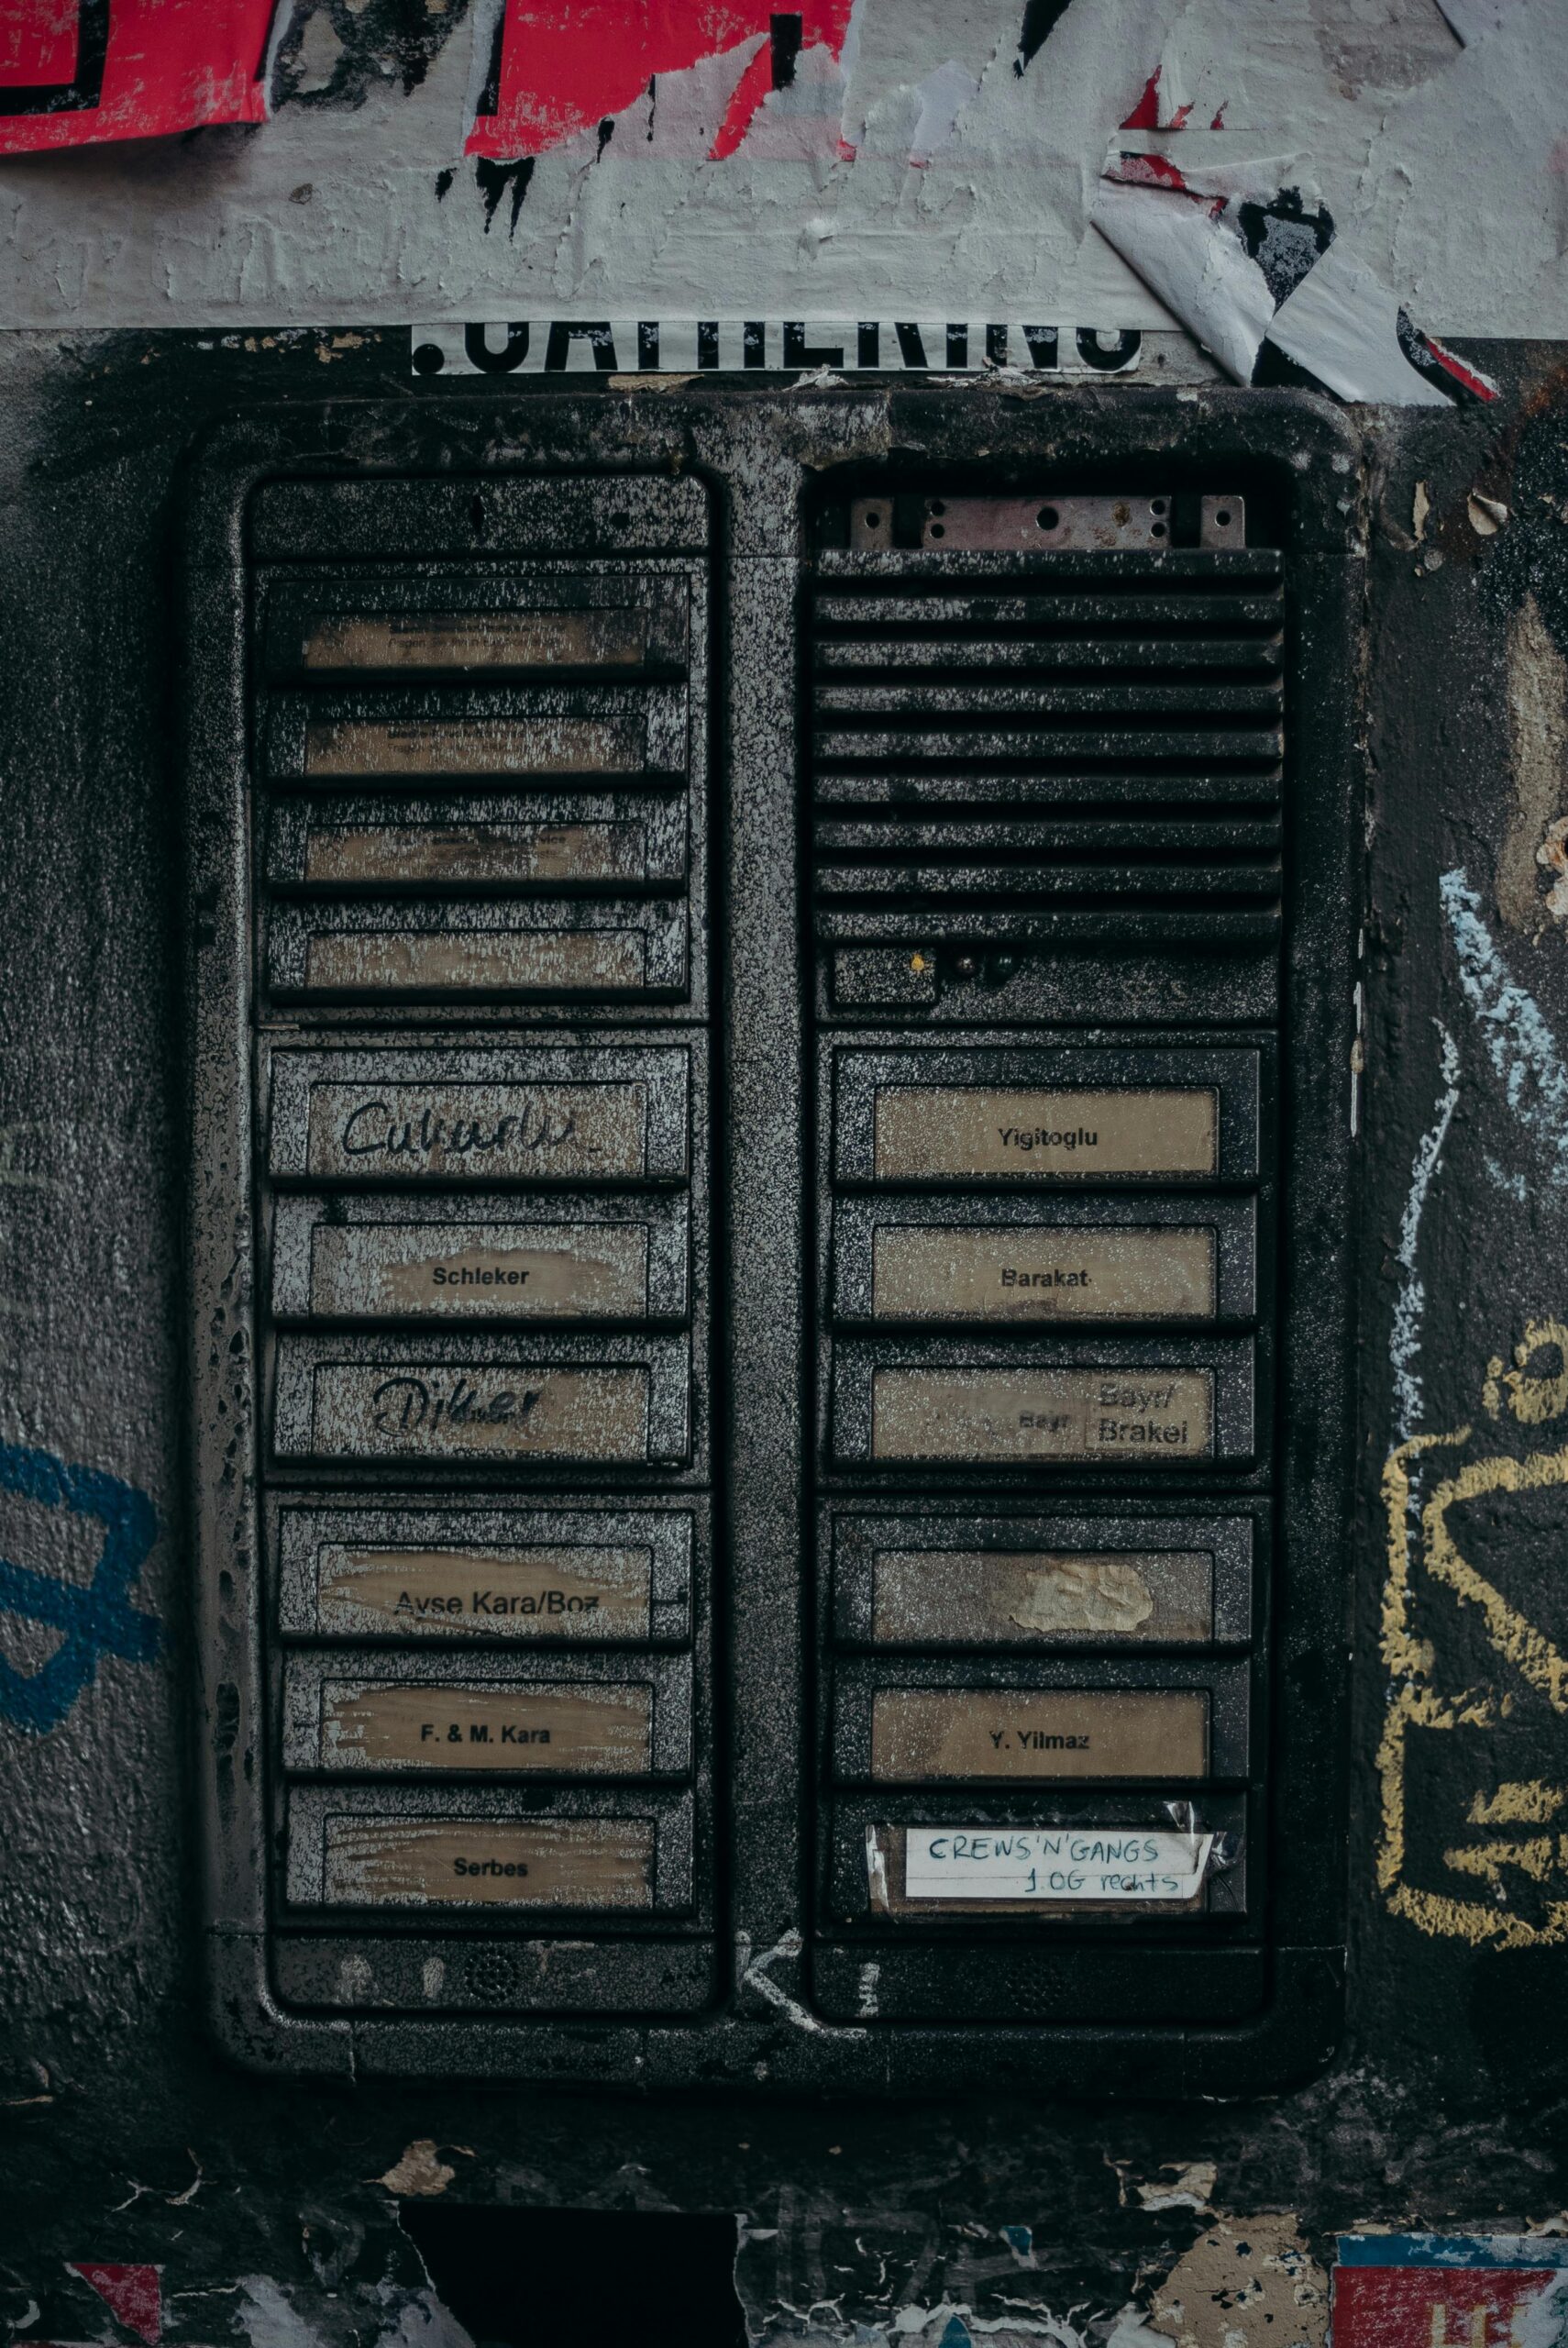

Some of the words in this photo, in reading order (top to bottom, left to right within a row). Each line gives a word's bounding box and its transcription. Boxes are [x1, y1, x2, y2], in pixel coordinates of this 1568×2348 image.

[432, 1268, 530, 1286] Schleker
[421, 1724, 440, 1743] F.
[447, 1724, 462, 1743] &
[469, 1724, 494, 1744] M.
[502, 1724, 551, 1744] Kara
[989, 1730, 1010, 1750] Y.
[1017, 1730, 1089, 1750] Yilmaz
[453, 1857, 529, 1877] Serbes
[1101, 1873, 1179, 1893] rechts
